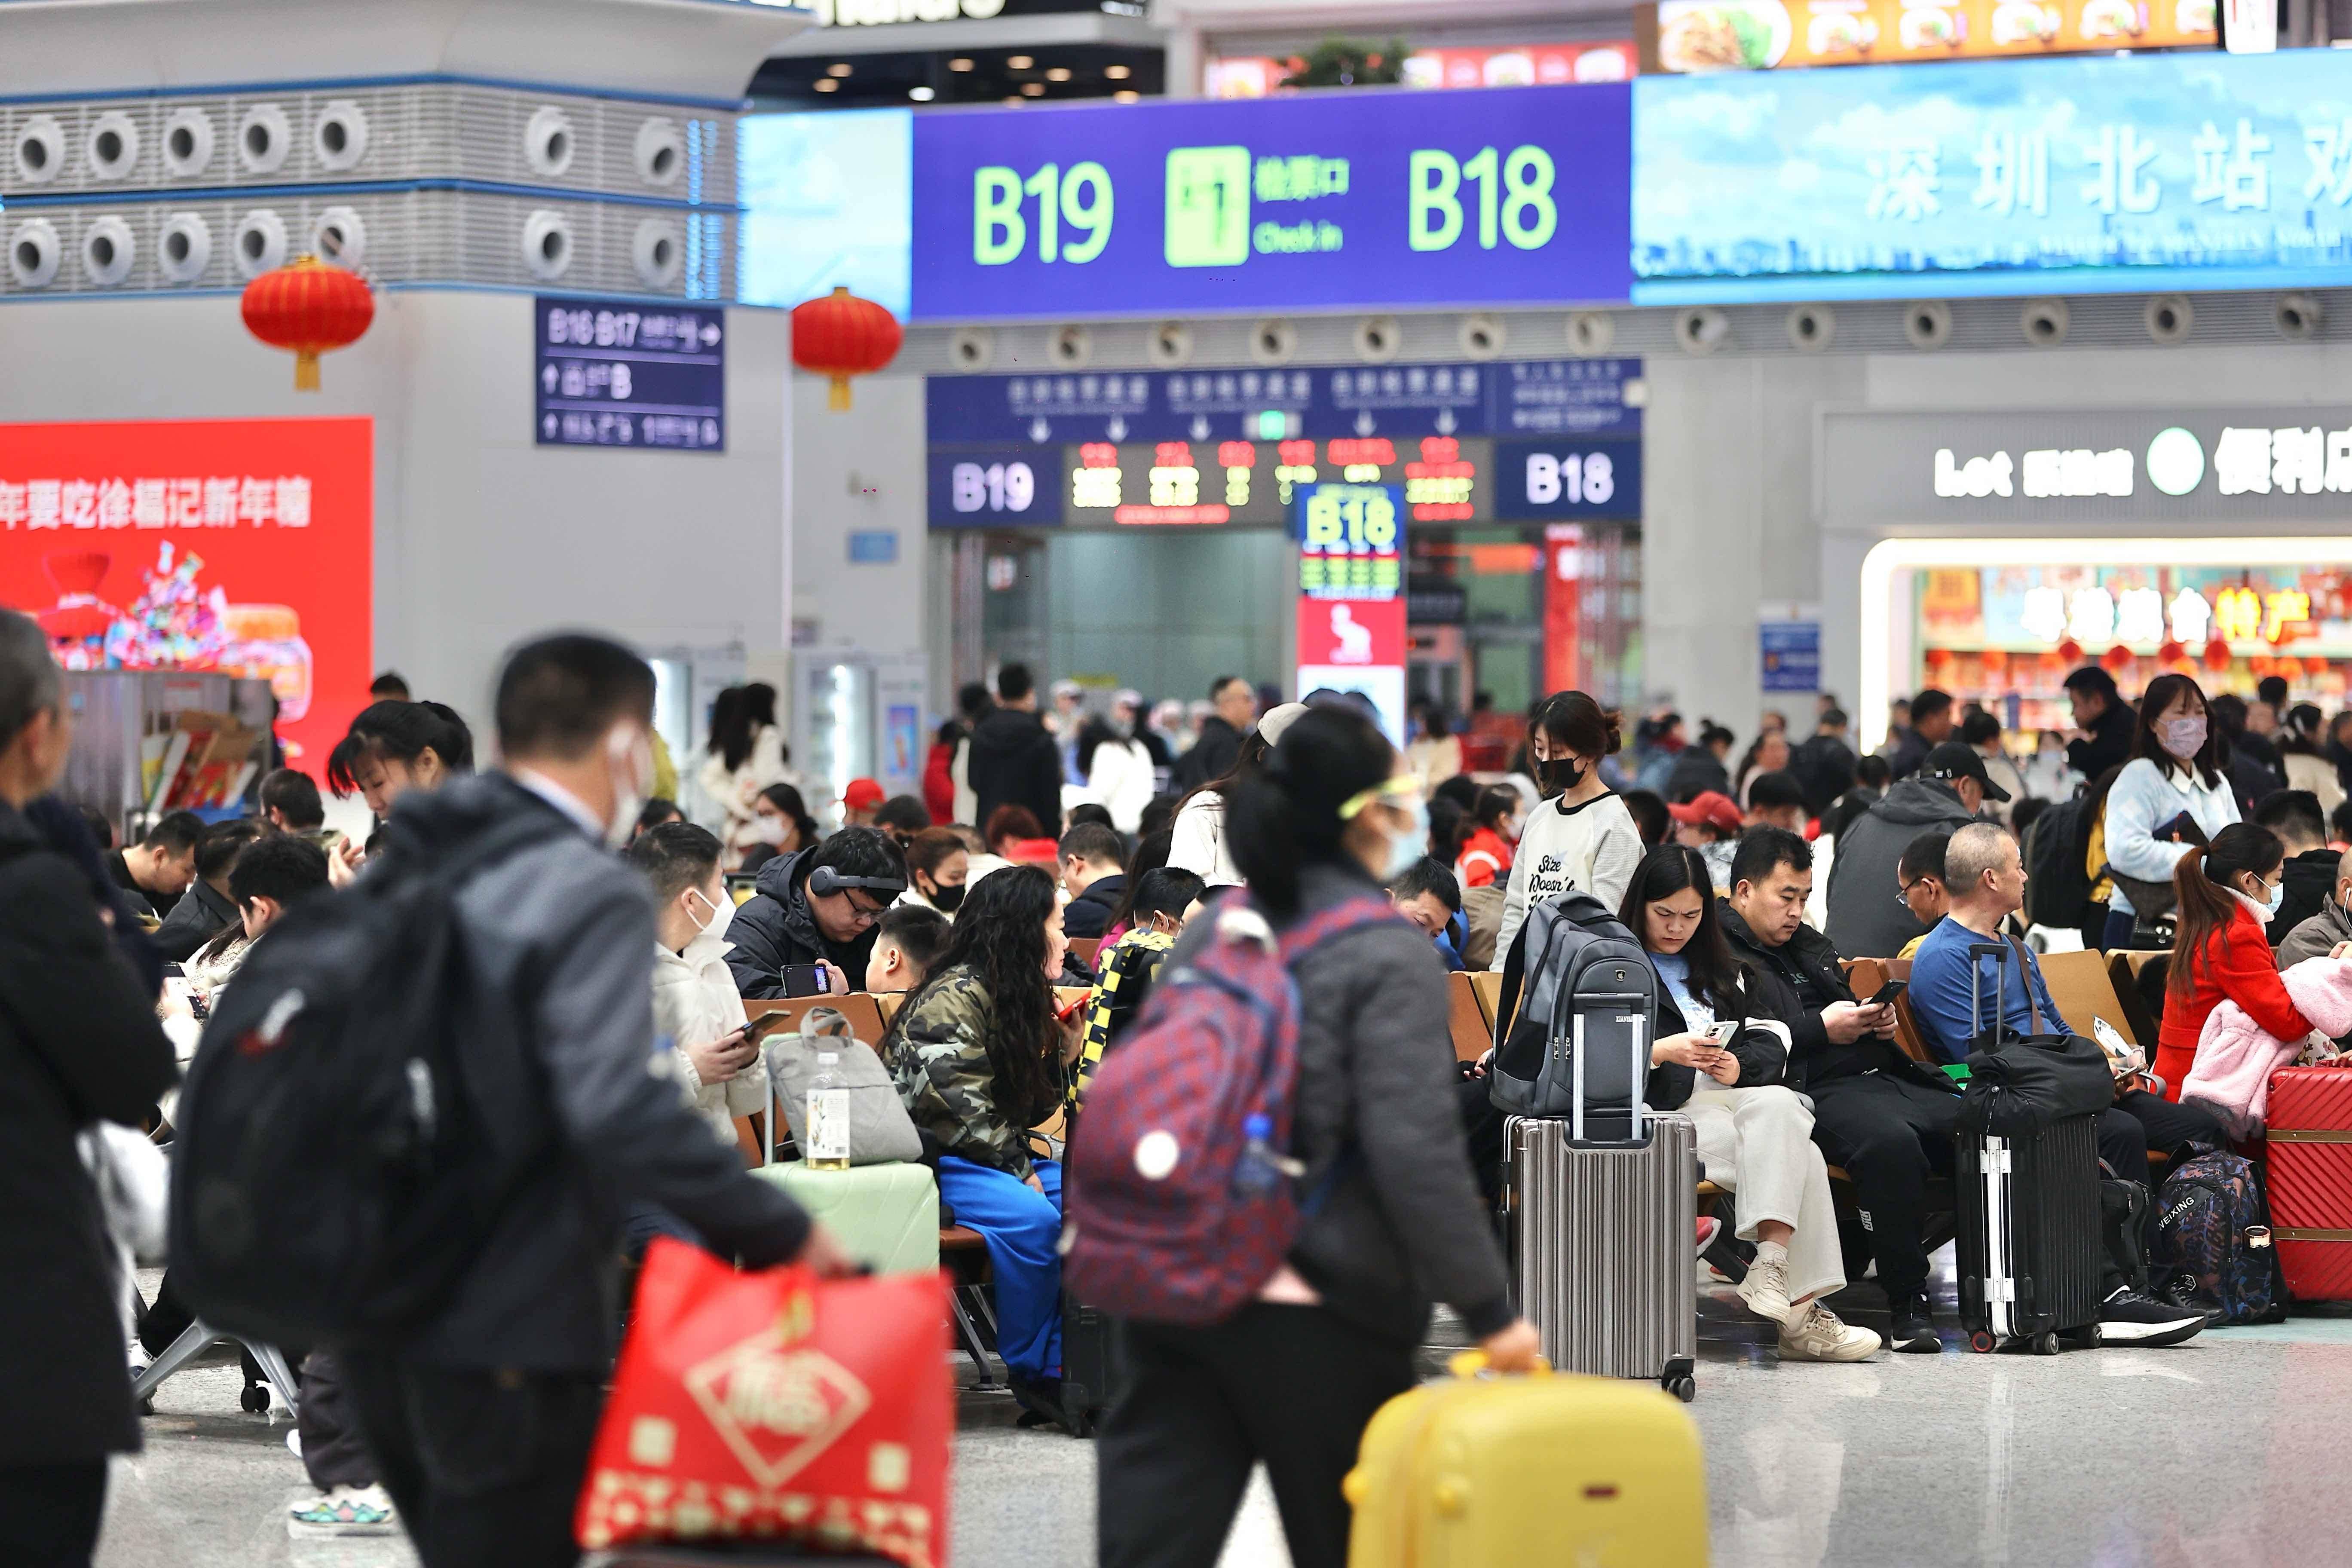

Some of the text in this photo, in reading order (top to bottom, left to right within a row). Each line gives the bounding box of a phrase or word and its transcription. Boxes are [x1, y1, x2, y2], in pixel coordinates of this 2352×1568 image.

[974, 161, 1114, 266] B19
[1408, 145, 1558, 252] B18
[952, 462, 1034, 512] B19
[1525, 452, 1614, 504] B18
[1306, 495, 1397, 546] B18
[1538, 854, 1562, 874] Size
